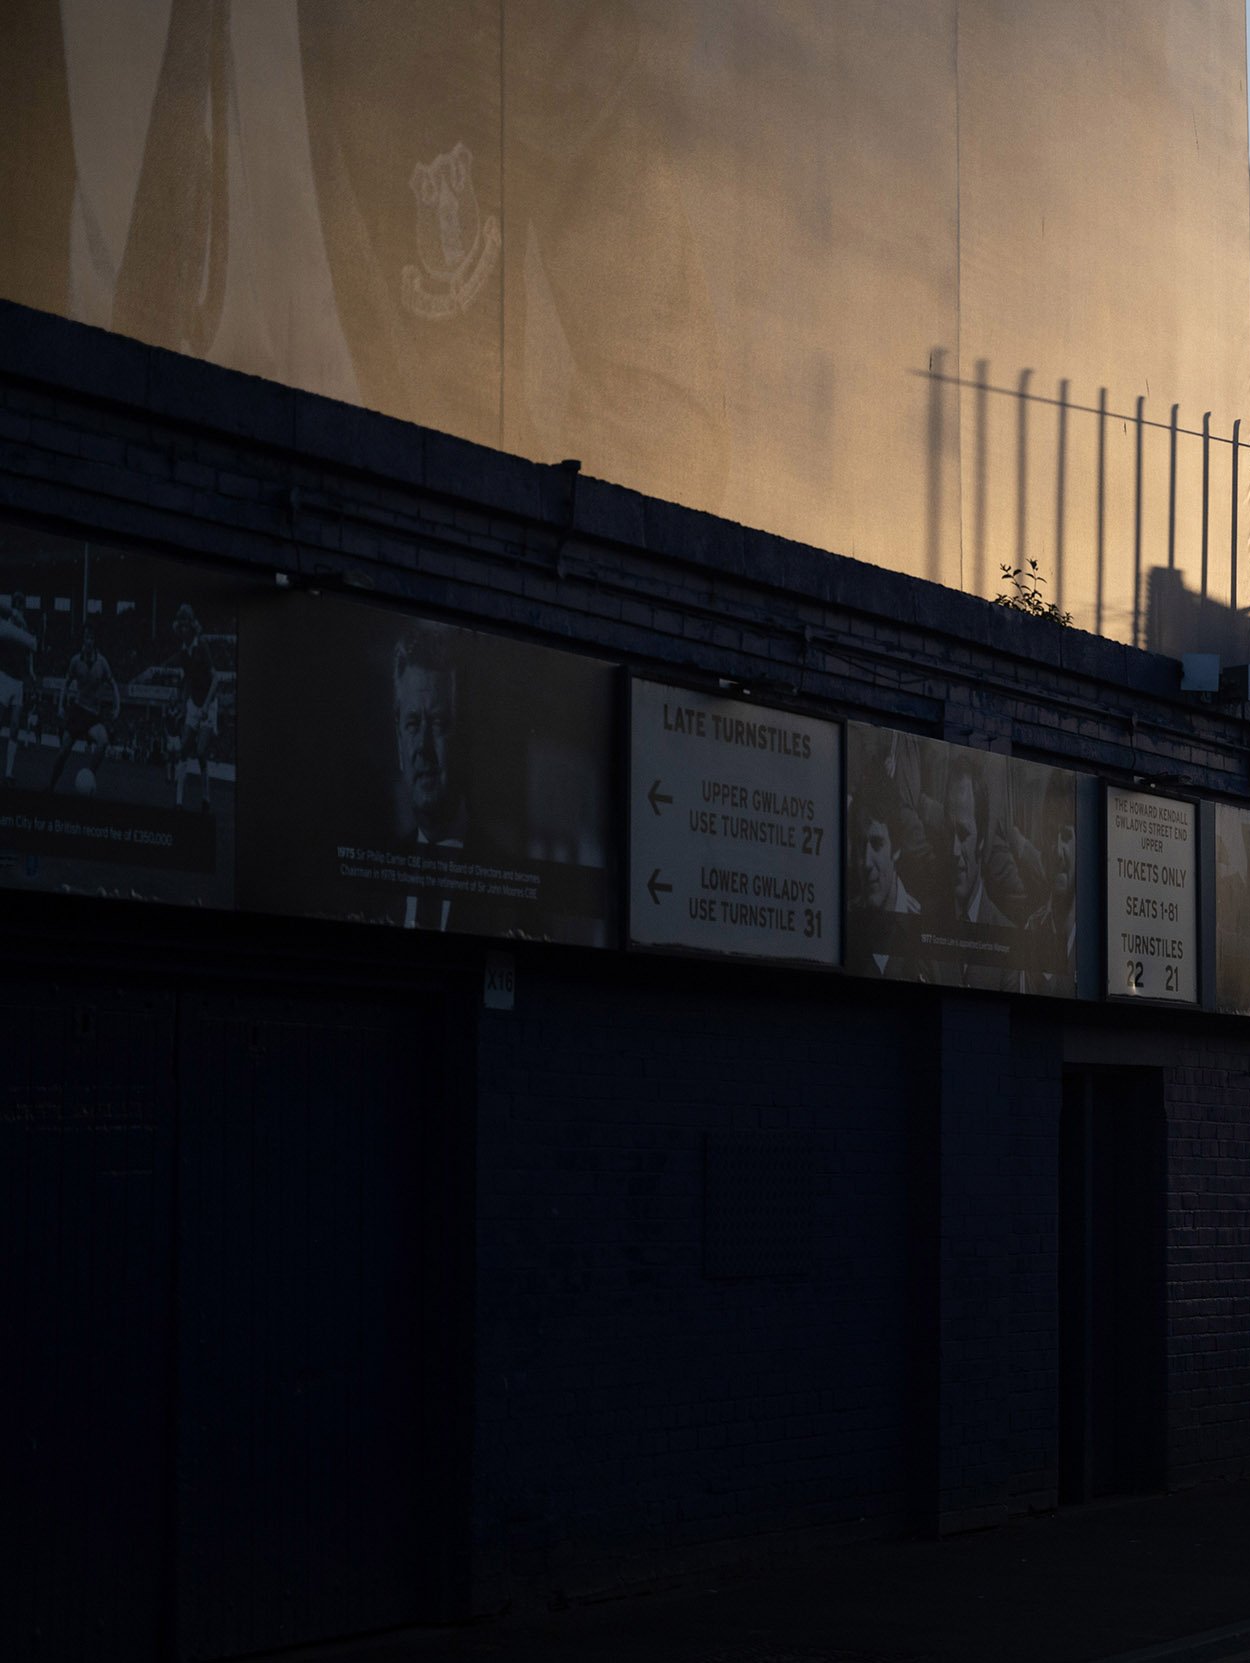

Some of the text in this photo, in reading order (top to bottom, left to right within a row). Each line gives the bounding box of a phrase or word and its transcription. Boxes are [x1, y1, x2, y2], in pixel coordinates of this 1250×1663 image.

[663, 704, 811, 759] LATE TURNSTILES
[702, 780, 815, 821] UPPER GWLADYS
[1115, 798, 1188, 825] THE HOWARD KENDALL
[689, 808, 824, 856] USE TURNSTILE 27
[1115, 815, 1188, 841] GWLADYS STREET END
[1141, 837, 1163, 853] UPPER
[701, 866, 815, 904] LOWER GWLADYS
[1117, 858, 1187, 888] TICKETS ONLY
[689, 897, 822, 938] USE TURNSTILE 31
[1126, 896, 1157, 919] SEATS
[1121, 933, 1184, 959] TURNSTILES
[1127, 960, 1179, 992] 22 21
